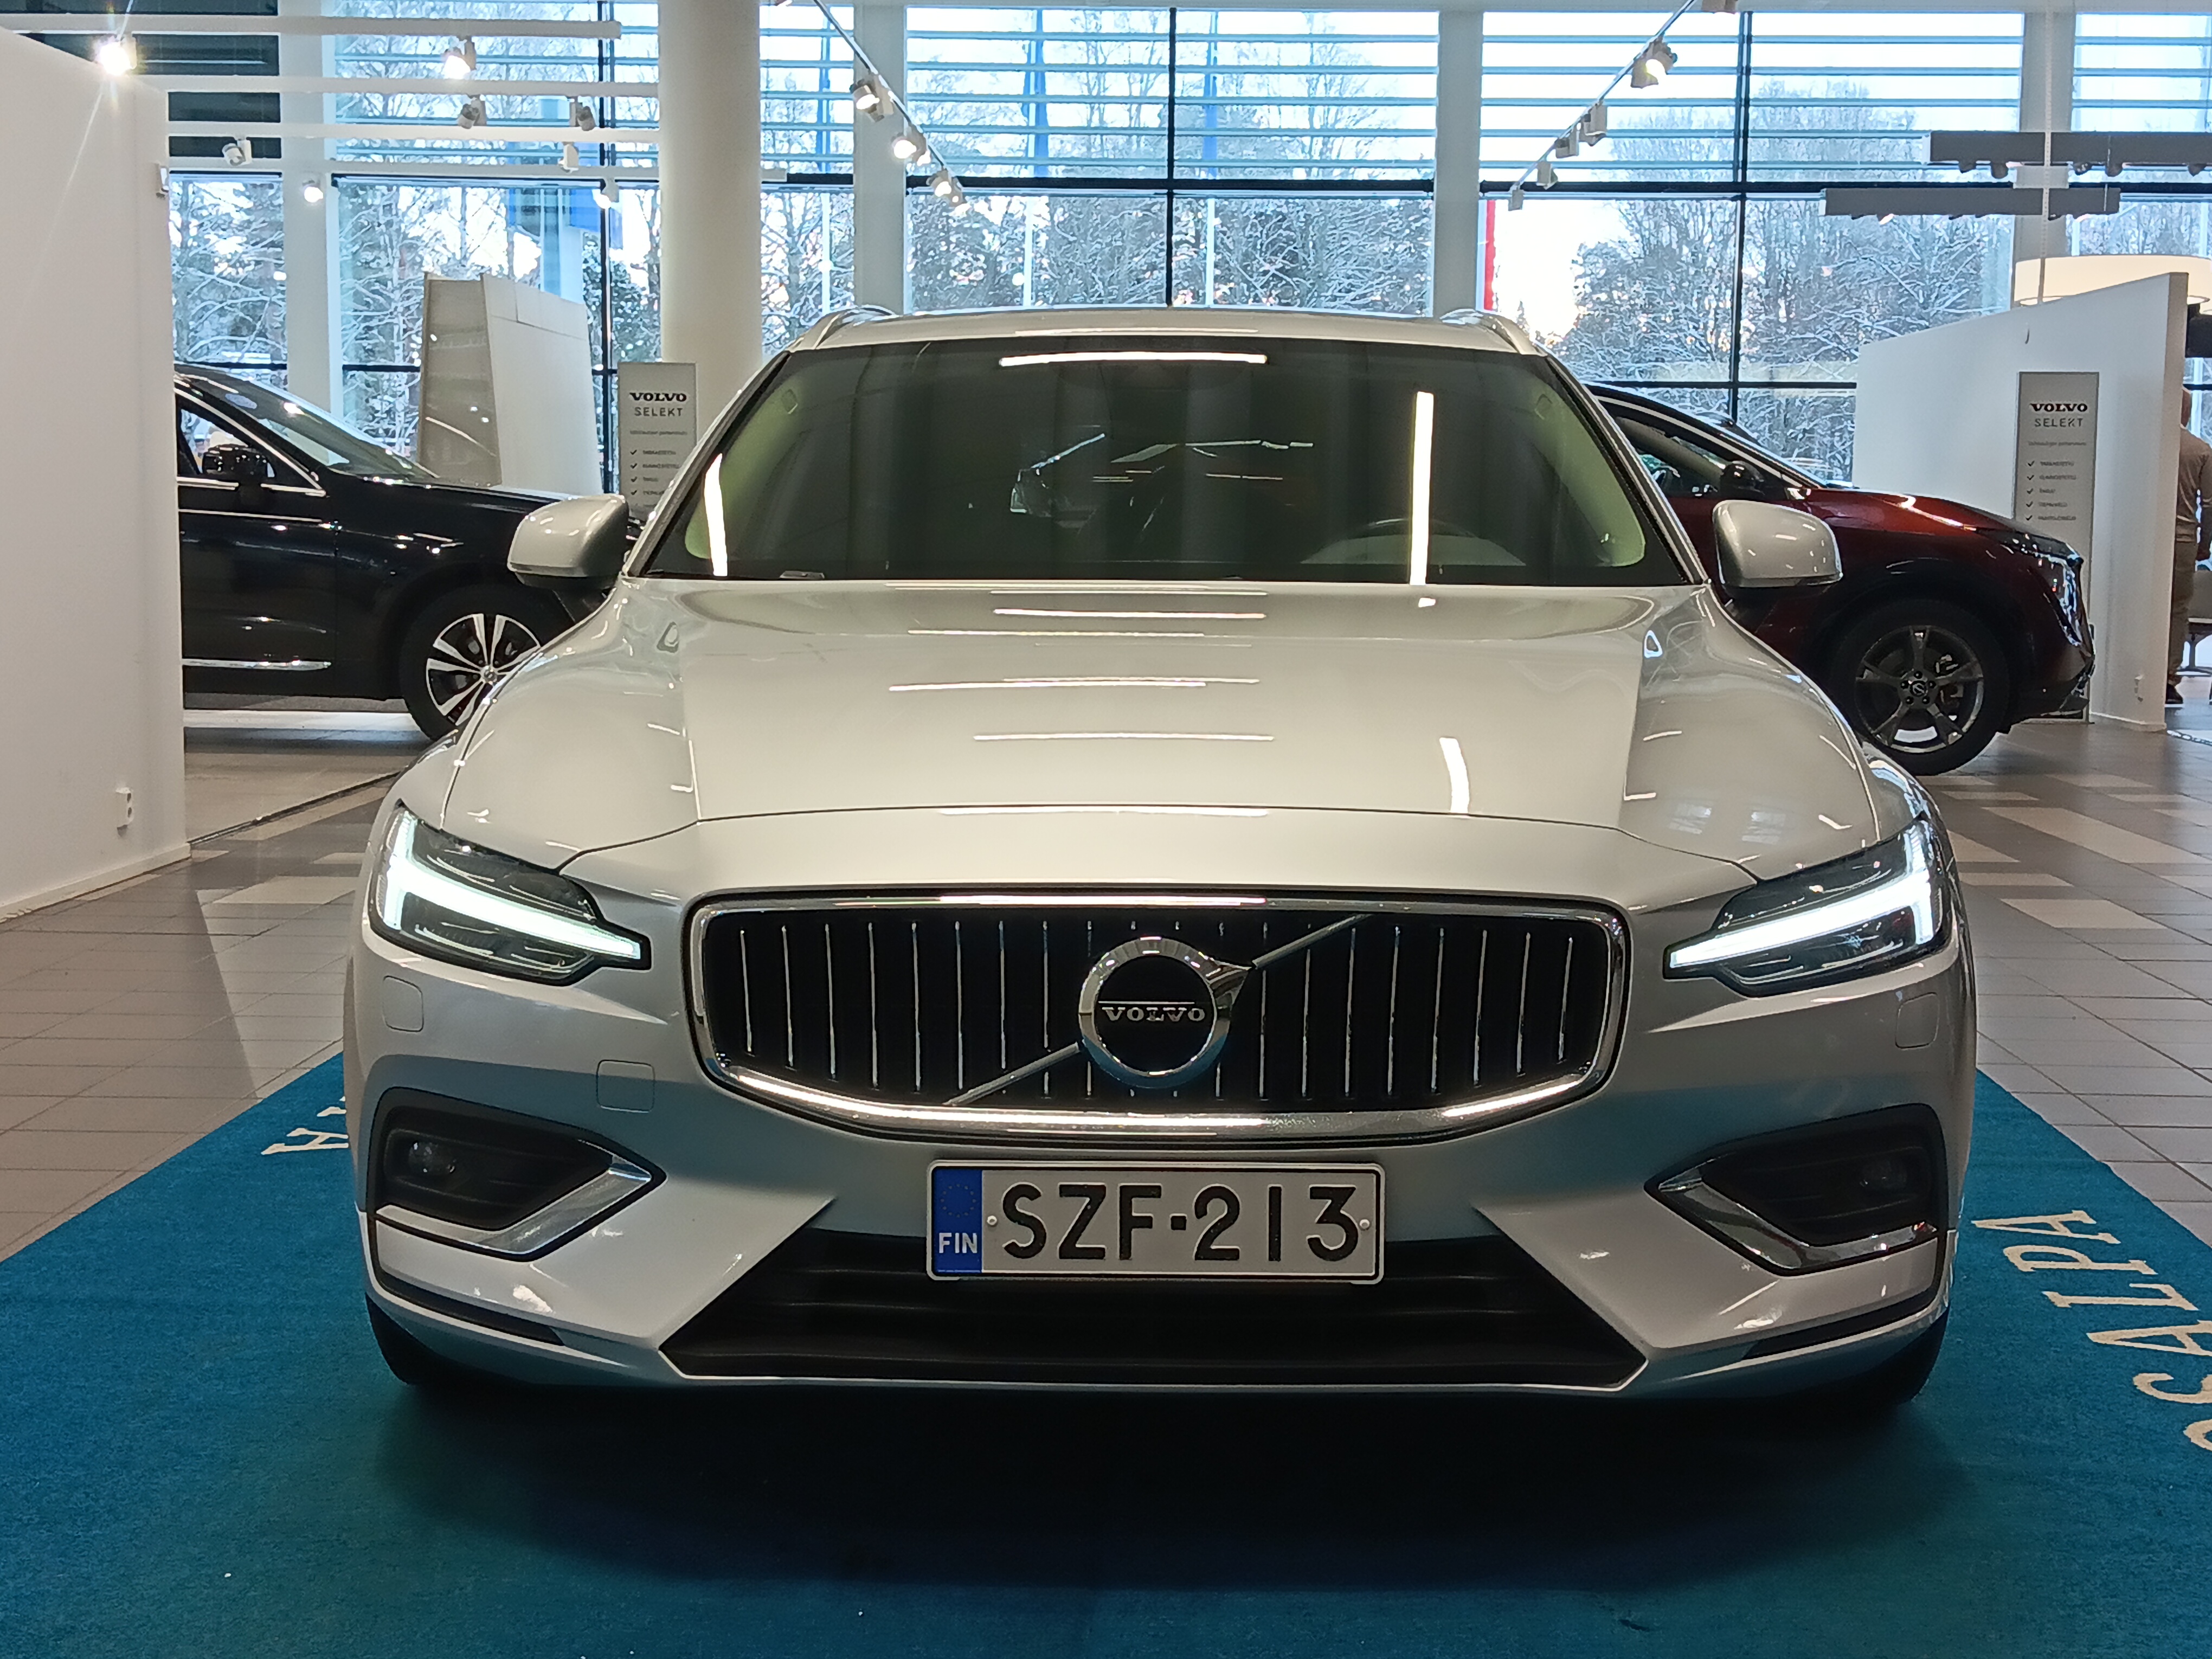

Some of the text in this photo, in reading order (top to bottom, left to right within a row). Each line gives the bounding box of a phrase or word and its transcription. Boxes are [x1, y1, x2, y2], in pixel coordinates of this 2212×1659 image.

[629, 393, 687, 402] VOLVO
[634, 407, 683, 416] SELEKT
[2030, 403, 2088, 412] VOLVO
[2035, 418, 2084, 427] SELEKT
[1102, 1007, 1205, 1021] VOLVO
[938, 1232, 978, 1253] FIN
[1971, 1210, 2212, 1451] SALPA
